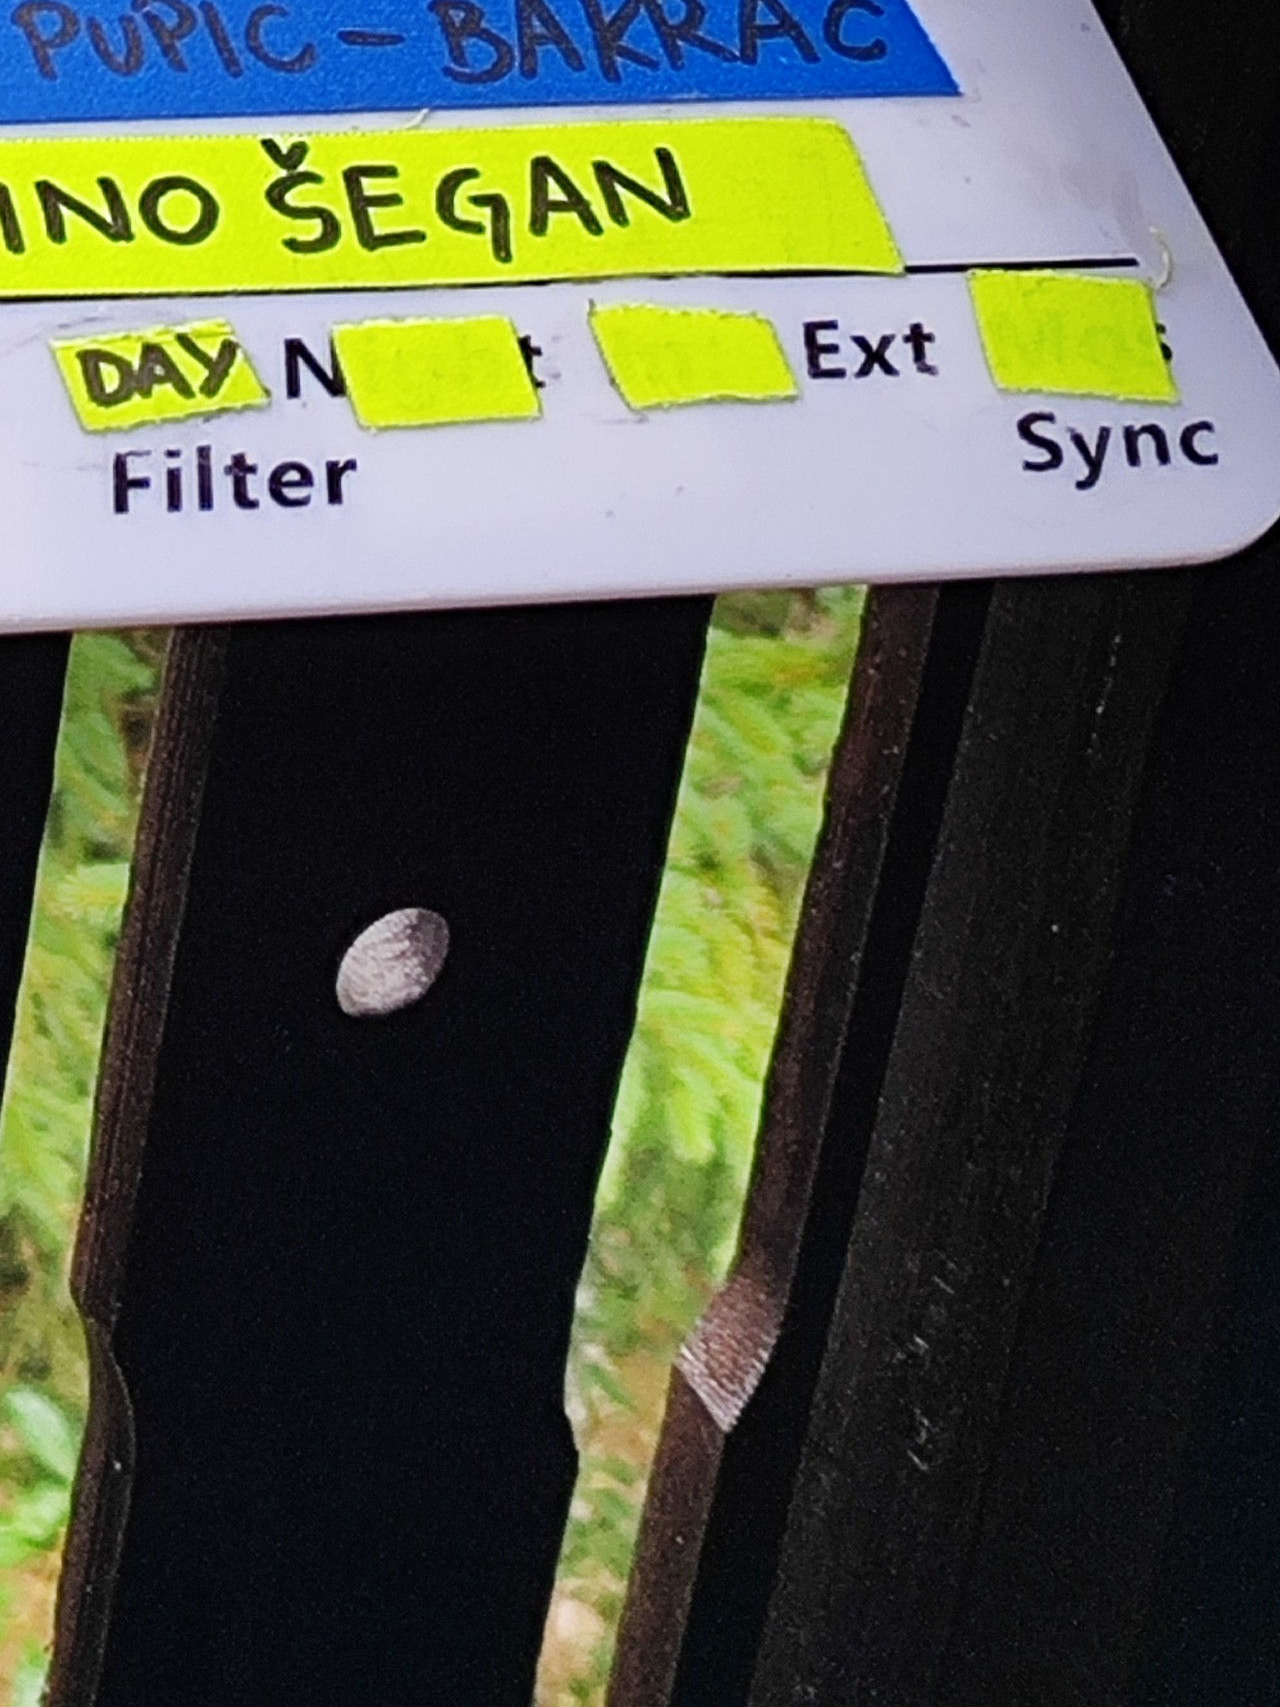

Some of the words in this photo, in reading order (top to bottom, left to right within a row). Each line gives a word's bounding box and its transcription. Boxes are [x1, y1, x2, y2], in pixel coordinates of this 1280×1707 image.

[260, 136, 690, 263] ŠEGAN
[75, 332, 242, 408] DAY
[802, 318, 939, 381] Ext
[111, 444, 358, 514] Filter
[1016, 411, 1219, 491] Sync
